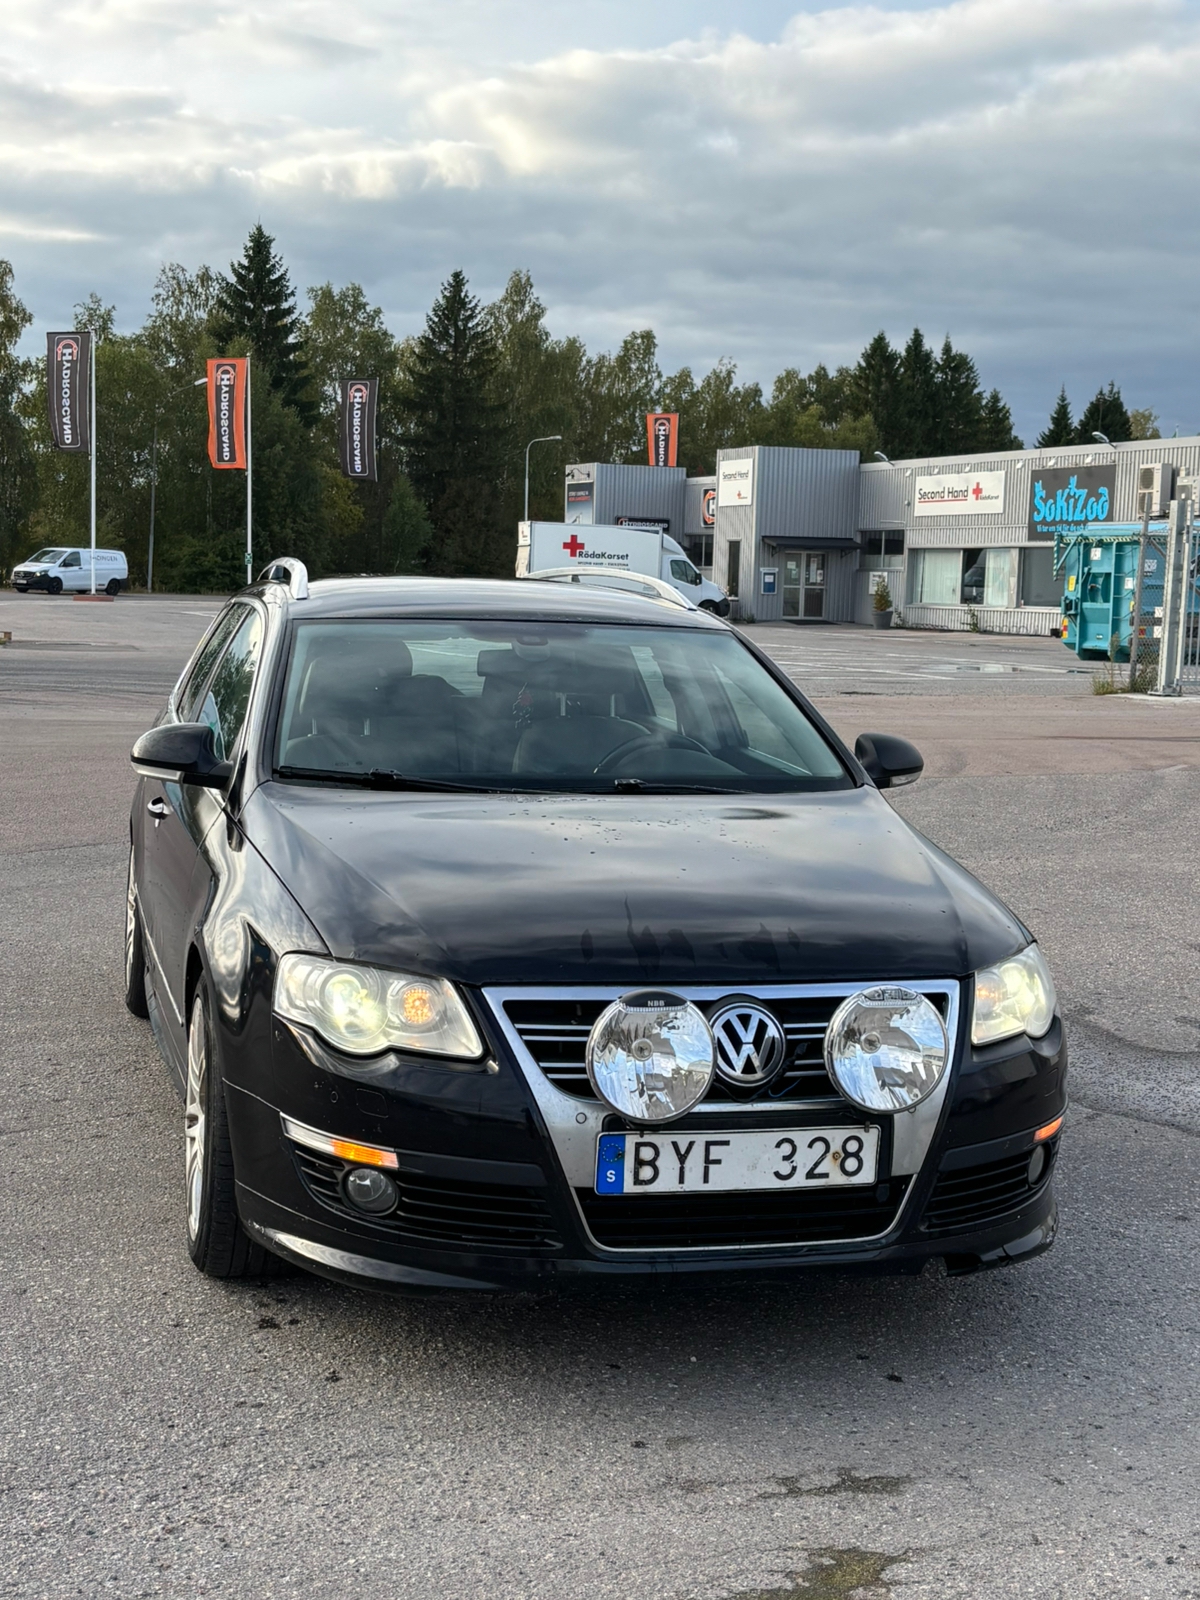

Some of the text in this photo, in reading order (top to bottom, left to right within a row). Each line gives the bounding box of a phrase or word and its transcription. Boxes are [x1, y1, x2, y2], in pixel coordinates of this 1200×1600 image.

[722, 469, 749, 480] Second Hand
[918, 486, 969, 500] Second Hand
[578, 550, 629, 560] RödaKorset
[633, 1135, 864, 1187] BYF 328
[606, 1170, 616, 1183] S
